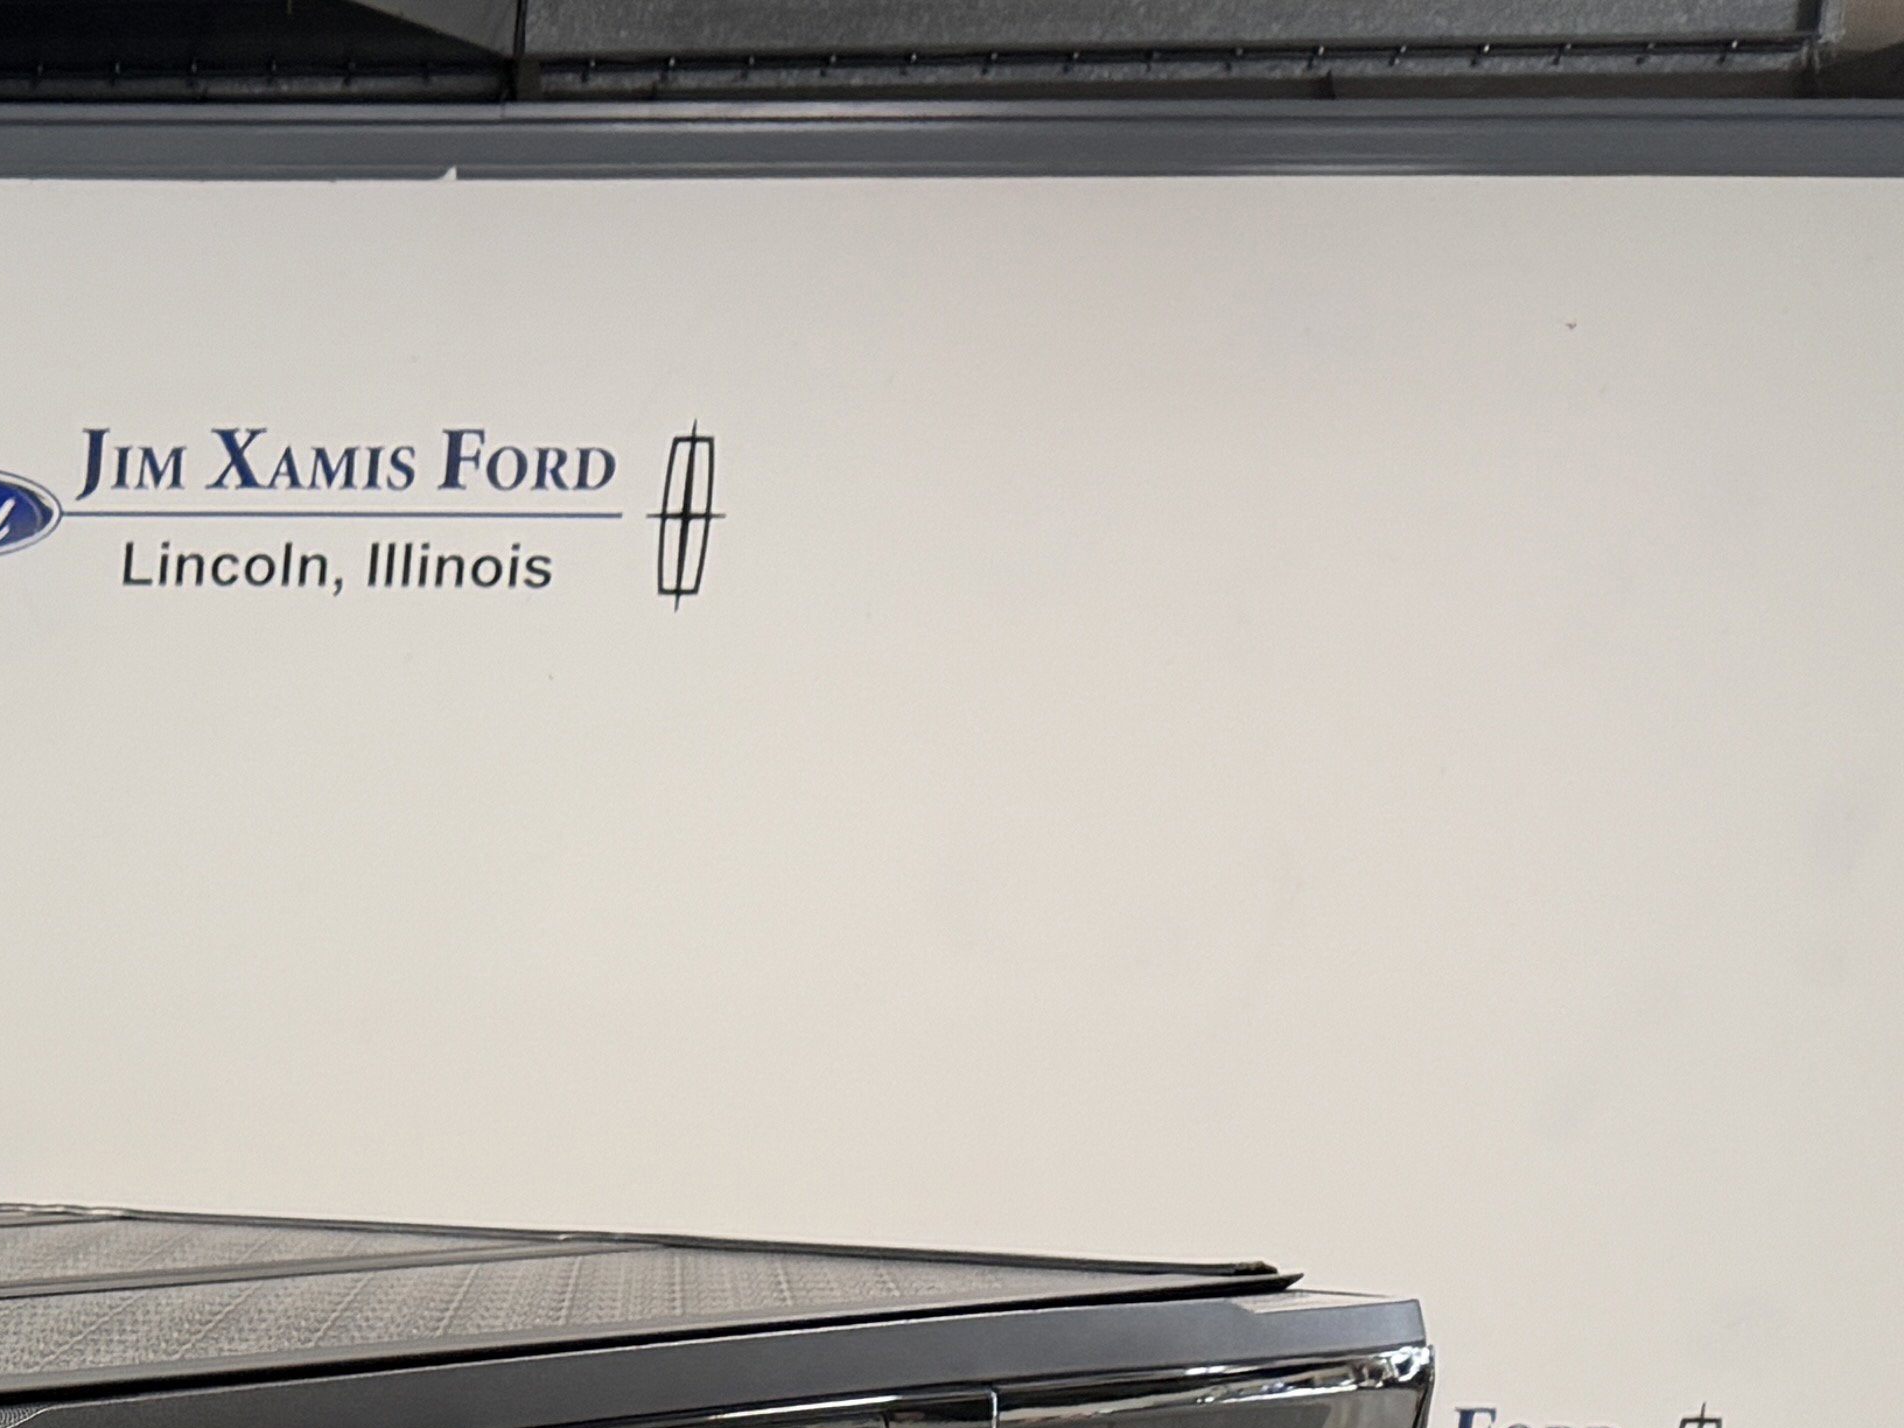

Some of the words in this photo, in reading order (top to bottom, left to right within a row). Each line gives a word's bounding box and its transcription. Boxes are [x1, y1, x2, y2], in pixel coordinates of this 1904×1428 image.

[75, 427, 186, 500] JIM
[204, 427, 417, 491] XAMIS
[437, 428, 619, 492] FORD
[122, 542, 345, 596] Lincoln,
[366, 542, 553, 589] Illinois
